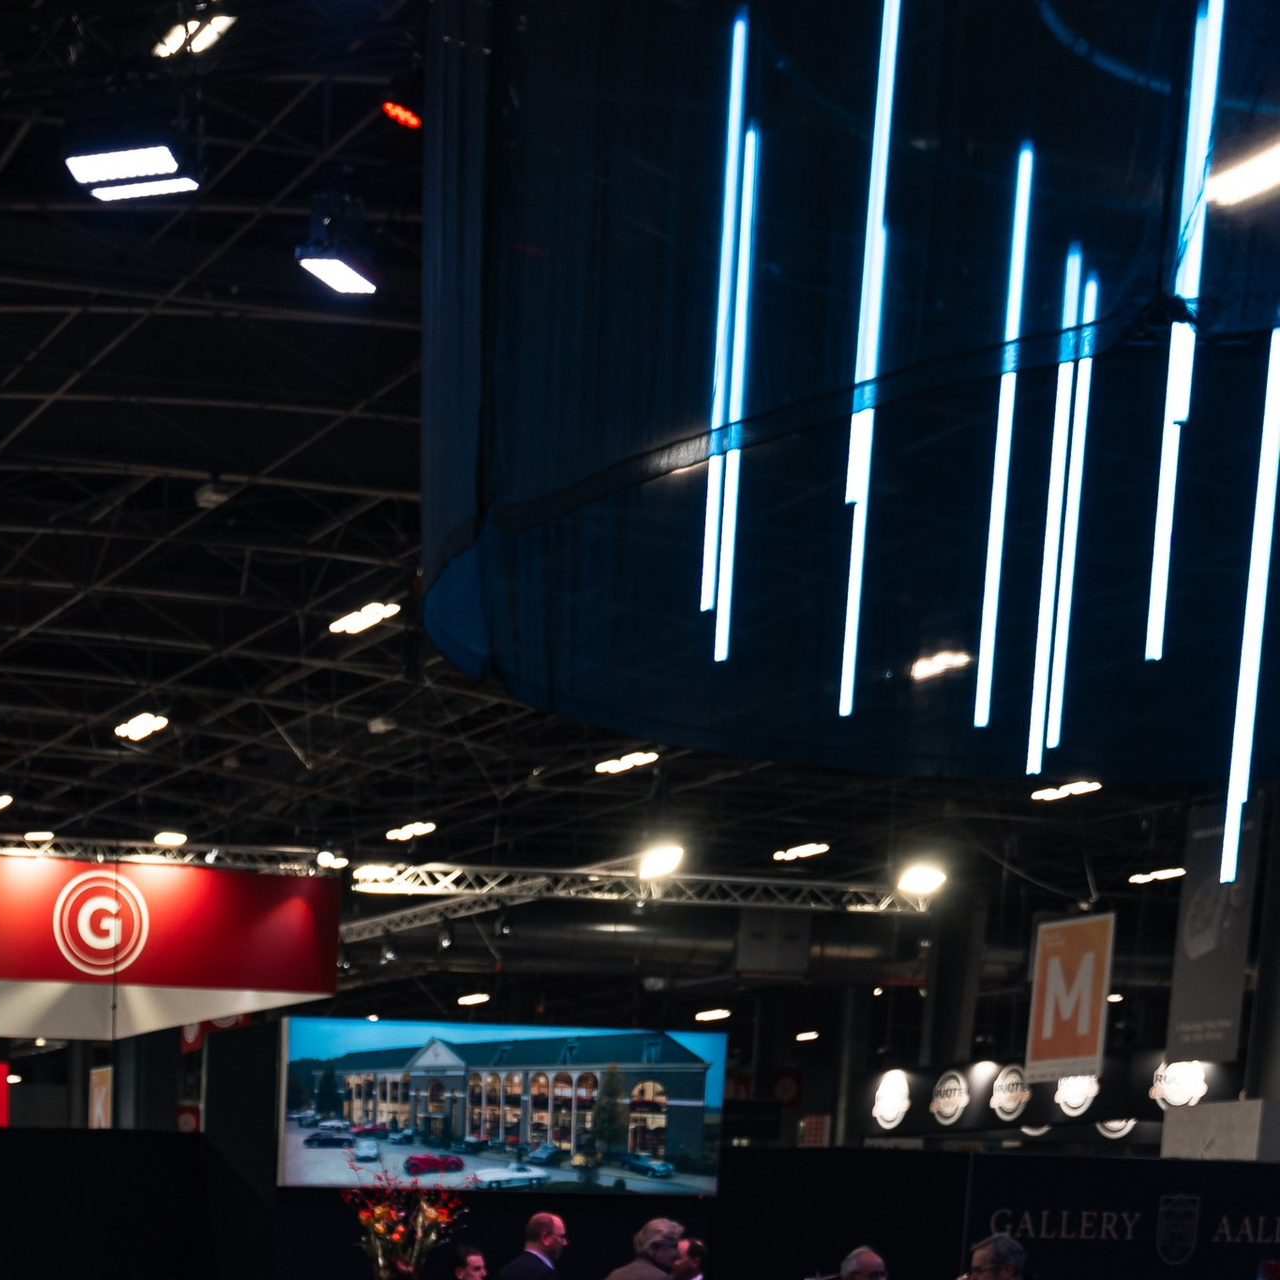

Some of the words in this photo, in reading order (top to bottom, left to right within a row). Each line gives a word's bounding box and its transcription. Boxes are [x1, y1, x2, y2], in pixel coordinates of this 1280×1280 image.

[77, 895, 123, 950] G
[1041, 950, 1096, 1040] M
[990, 1208, 1143, 1241] GALLERY
